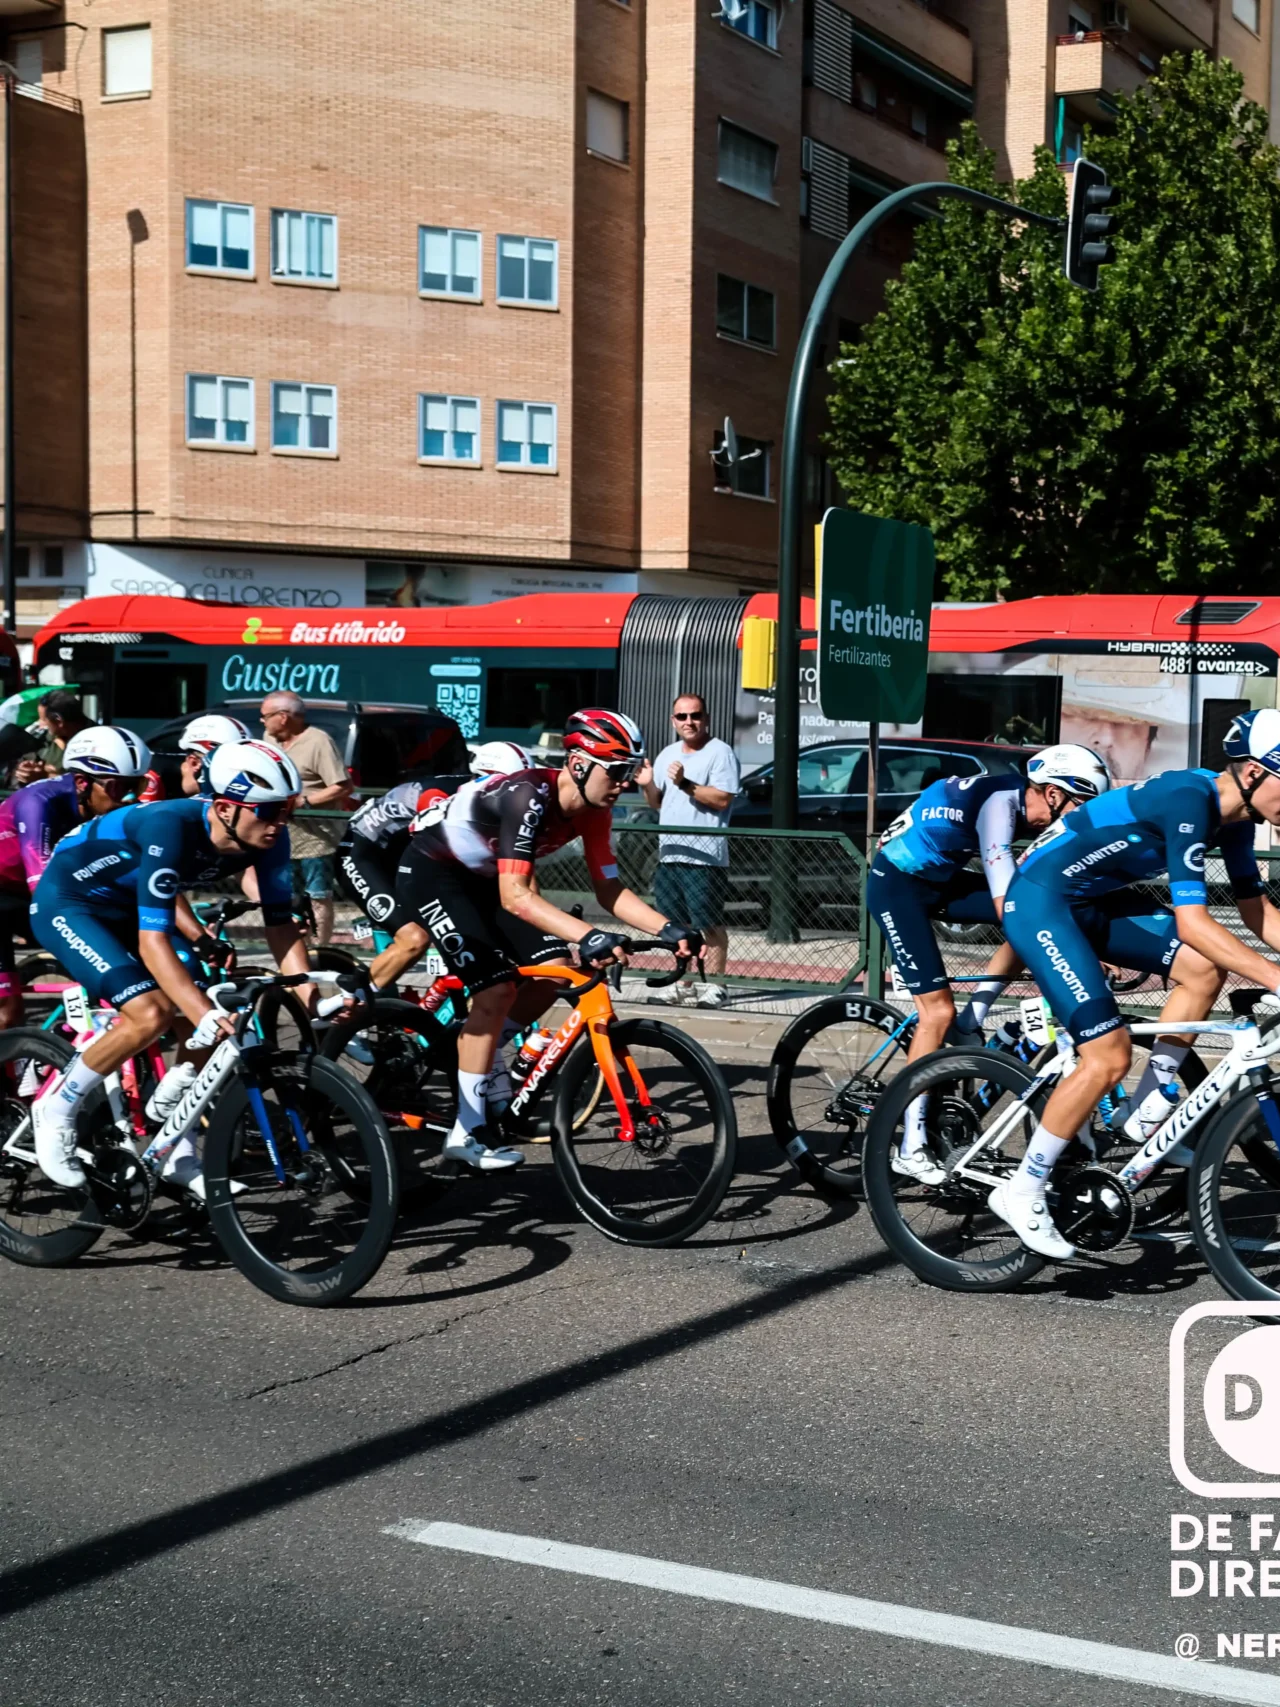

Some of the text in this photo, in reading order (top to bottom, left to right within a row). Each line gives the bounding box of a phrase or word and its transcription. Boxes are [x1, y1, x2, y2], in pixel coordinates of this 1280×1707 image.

[289, 621, 325, 643] Bus
[829, 600, 924, 643] Fertiberia
[828, 644, 892, 668] Fertilizantes
[1107, 642, 1171, 653] HYBRID
[221, 653, 341, 693] Gustera
[1160, 656, 1254, 674] 4881 avanza
[364, 801, 412, 832] ARKEA
[514, 798, 546, 854] INEOS
[921, 806, 965, 823] FACTOR
[1062, 840, 1129, 877] FDJ UNITED
[341, 856, 371, 900] ARKEA
[52, 915, 112, 973] Groupama
[418, 898, 475, 969] INEOS
[880, 911, 904, 949] ISRAEL
[430, 958, 441, 976] 61
[1036, 930, 1091, 1004] Groupama
[67, 993, 85, 1020] 137
[1025, 1005, 1045, 1033] 134
[510, 1010, 583, 1116] PINARELLO
[909, 1060, 981, 1090] MICHE
[1144, 1065, 1231, 1158] Wilier
[959, 1253, 1028, 1283] MICHE
